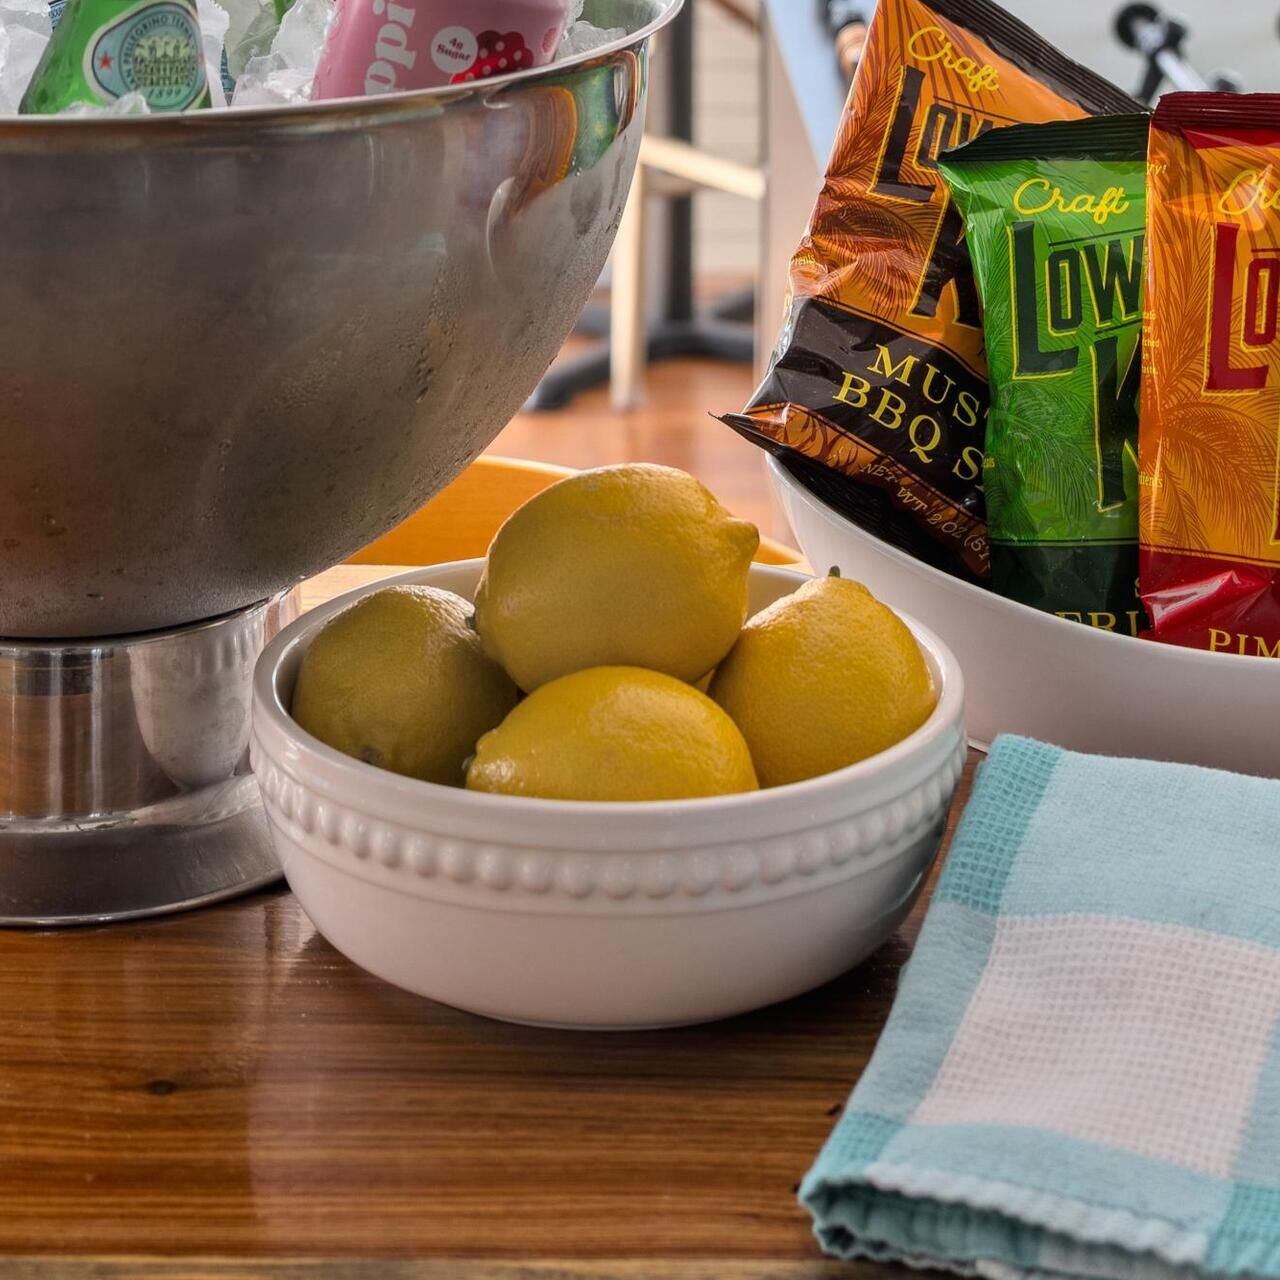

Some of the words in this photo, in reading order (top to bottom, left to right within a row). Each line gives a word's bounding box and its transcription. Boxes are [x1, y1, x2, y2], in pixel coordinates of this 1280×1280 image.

[436, 43, 471, 61] Sugar
[907, 25, 1000, 93] Craft
[1013, 178, 1129, 225] Craft
[832, 371, 942, 464] BBQ
[860, 463, 899, 484] NET
[896, 486, 928, 512] WT
[941, 521, 969, 539] OZ
